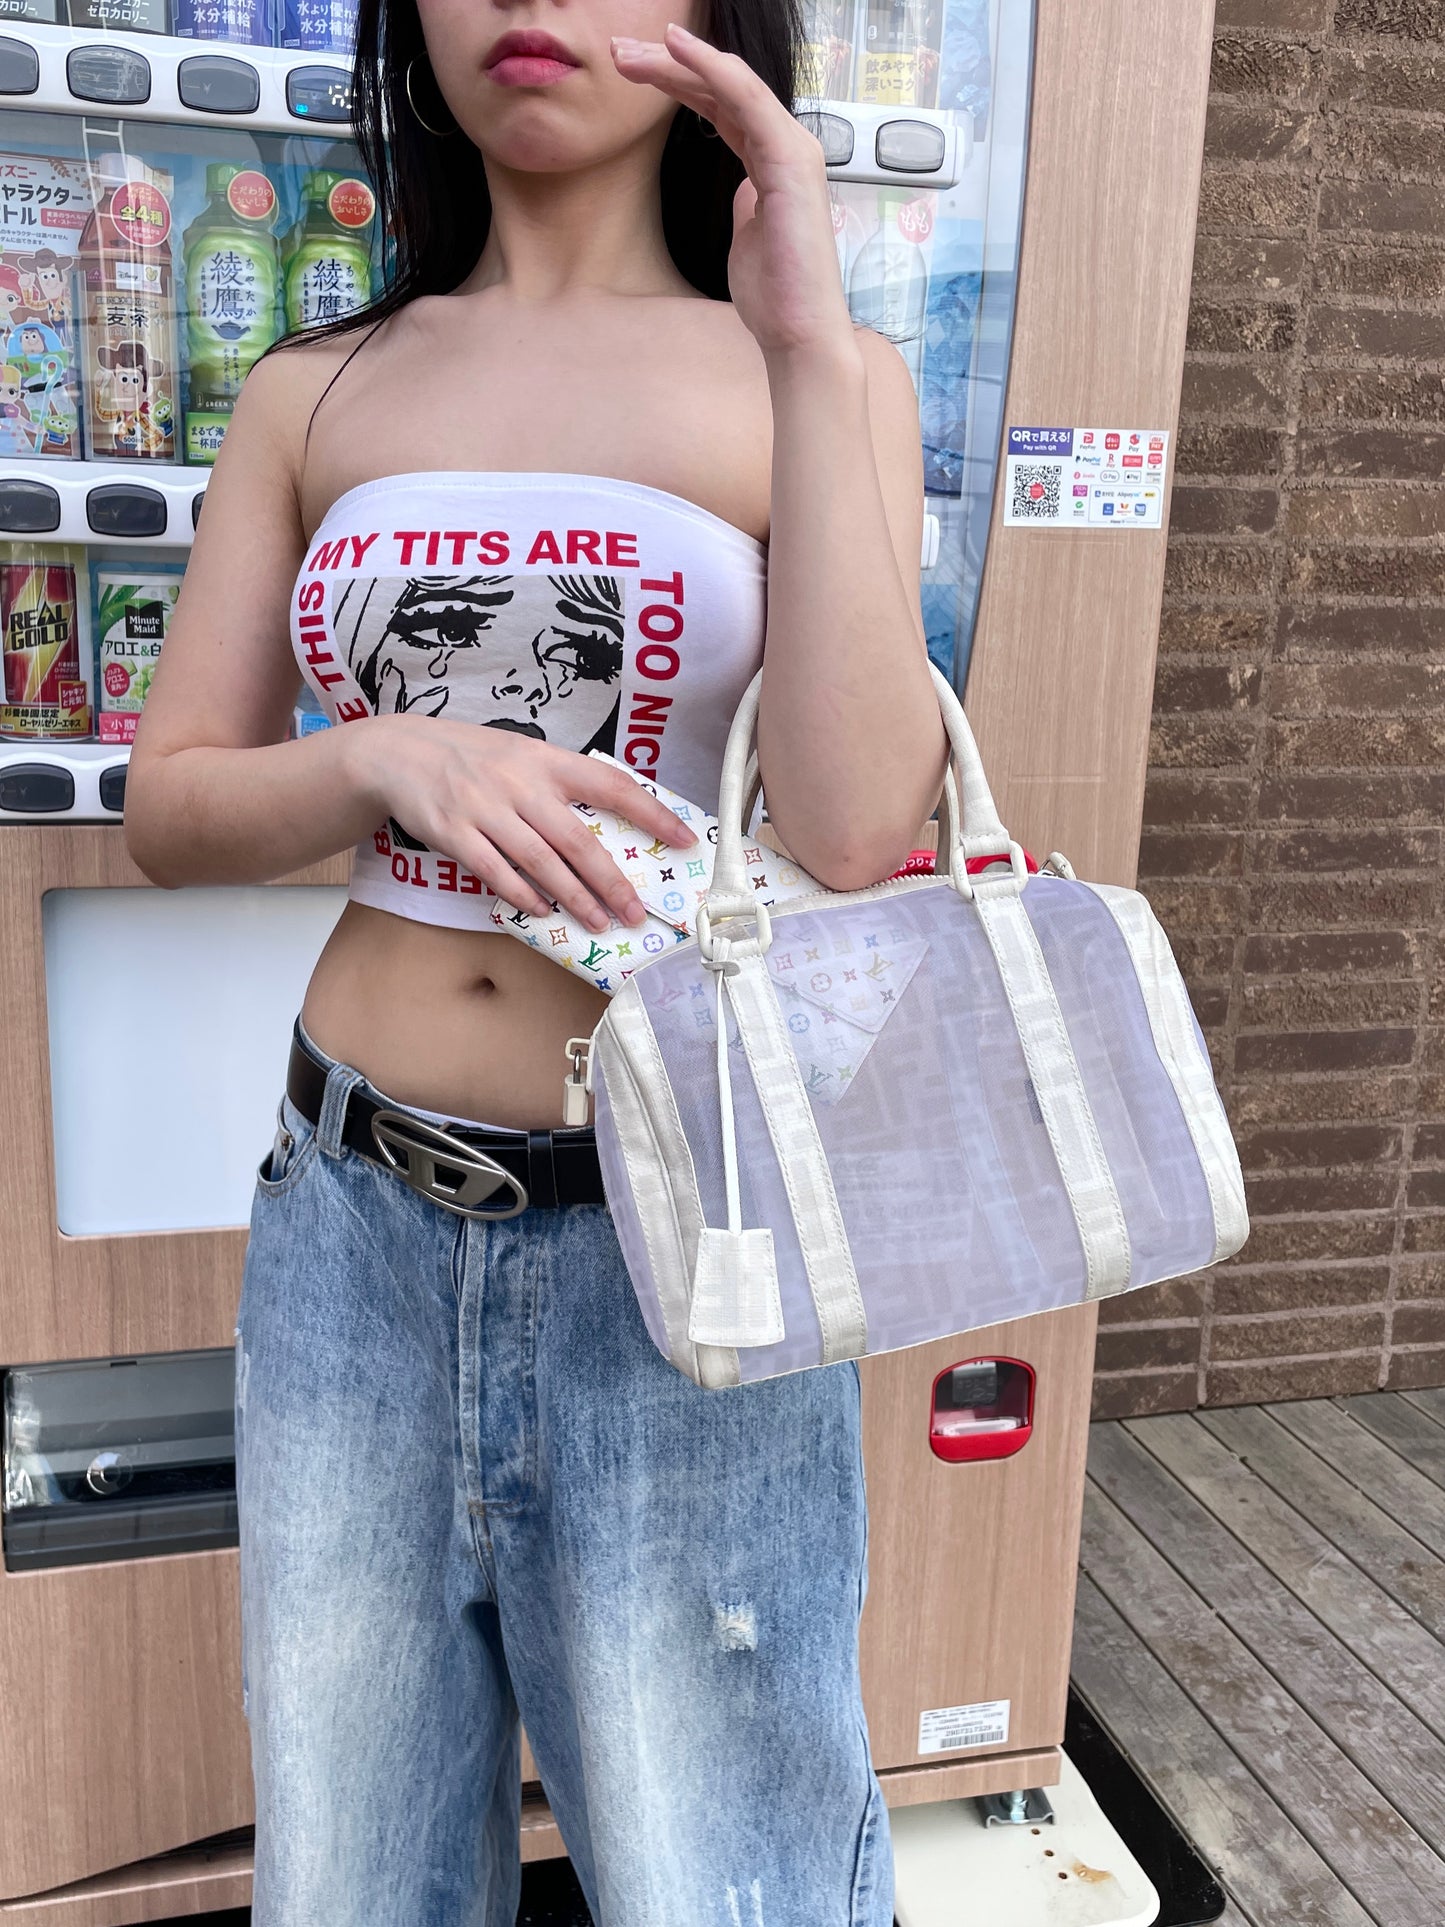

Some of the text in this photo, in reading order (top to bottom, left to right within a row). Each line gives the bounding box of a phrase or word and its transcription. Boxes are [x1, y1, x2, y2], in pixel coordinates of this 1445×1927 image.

[193, 7, 250, 28] 水分補給
[865, 77, 916, 92] 深いコク
[2, 183, 84, 206] ャラクター
[231, 185, 272, 198] こだわりの
[333, 195, 371, 207] こだわりの
[120, 205, 164, 228] 全4種
[336, 205, 368, 216] おいしさ
[210, 251, 246, 321] 綾鷹
[107, 306, 149, 329] 麦茶
[1011, 430, 1070, 444] QRで買える!
[307, 530, 640, 573] MY TITS ARE
[10, 601, 68, 631] REAL
[129, 615, 160, 626] Minute
[11, 622, 69, 652] GOLD
[133, 625, 157, 634] Maid
[299, 579, 345, 692] THIS
[624, 571, 685, 782] TOO NIC
[391, 852, 428, 888] TO
